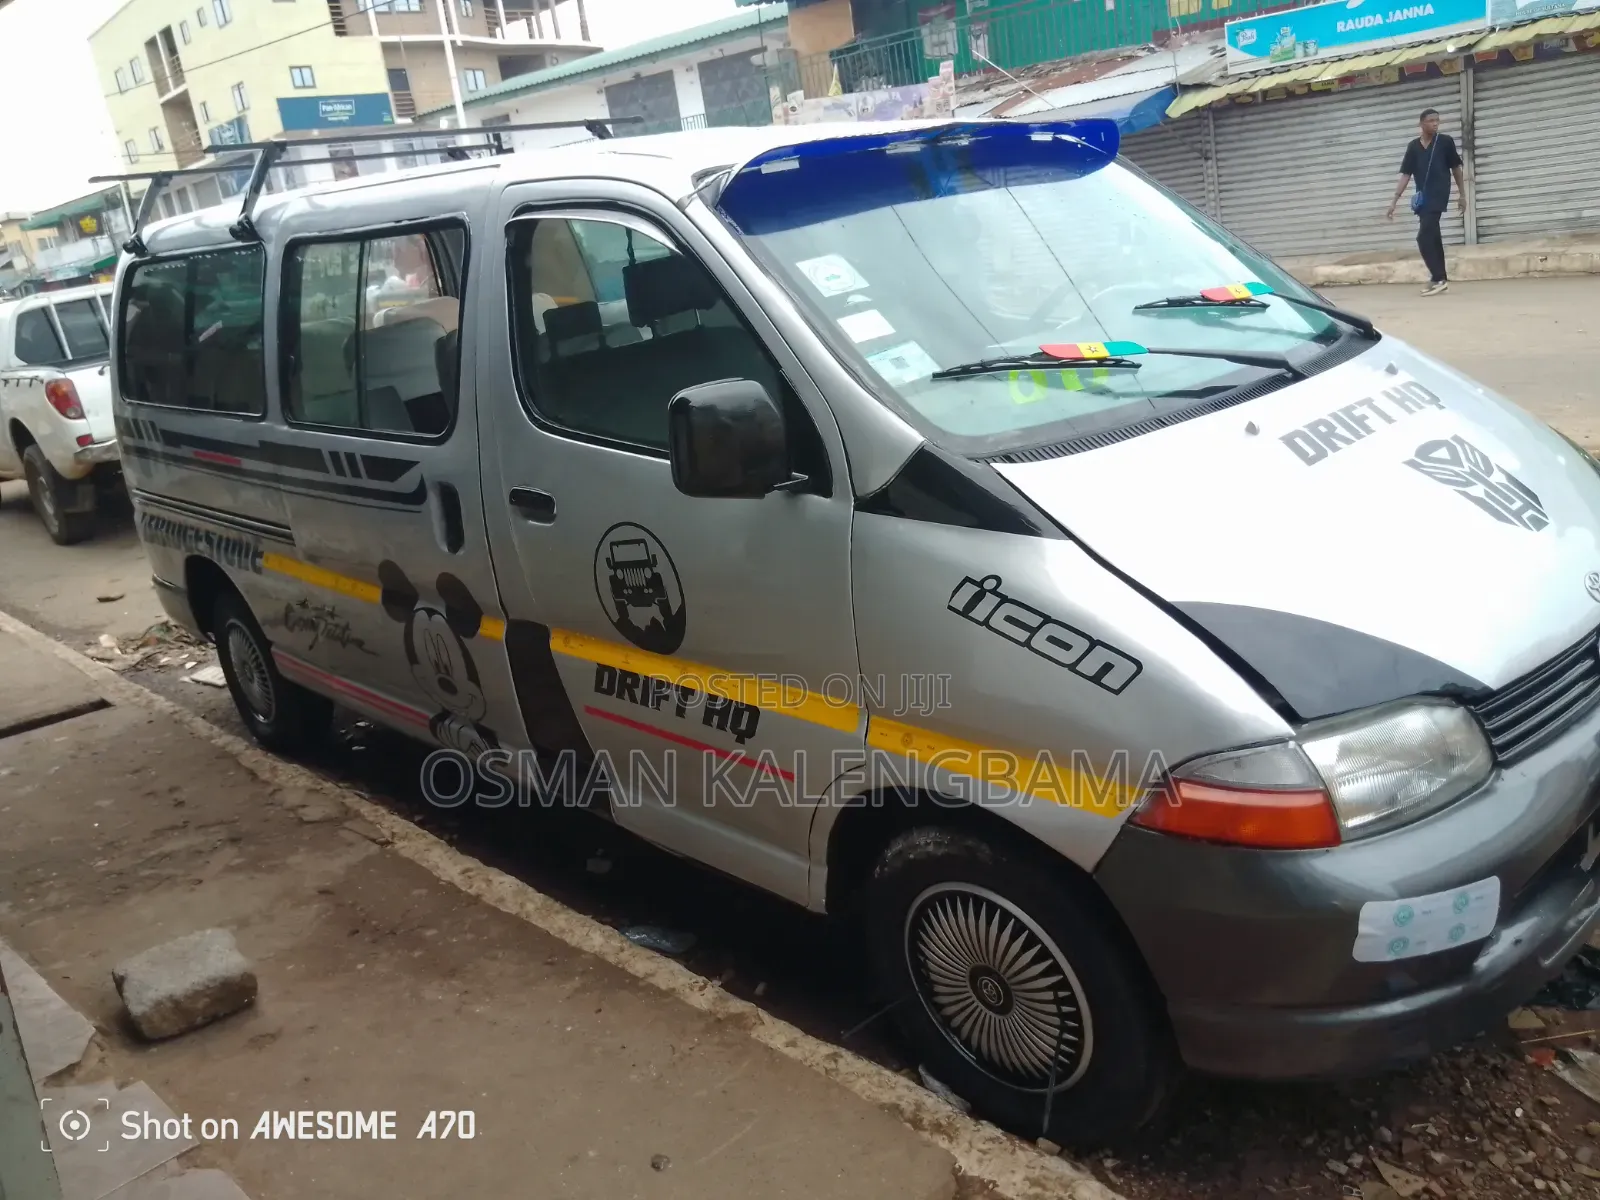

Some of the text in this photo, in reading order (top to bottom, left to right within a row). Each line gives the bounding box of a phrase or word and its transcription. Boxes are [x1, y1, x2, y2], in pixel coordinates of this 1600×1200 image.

[1336, 3, 1435, 33] RAUDA JANNA
[1278, 380, 1446, 467] DRIFT HQ
[594, 662, 761, 745] DRIFT HQ
